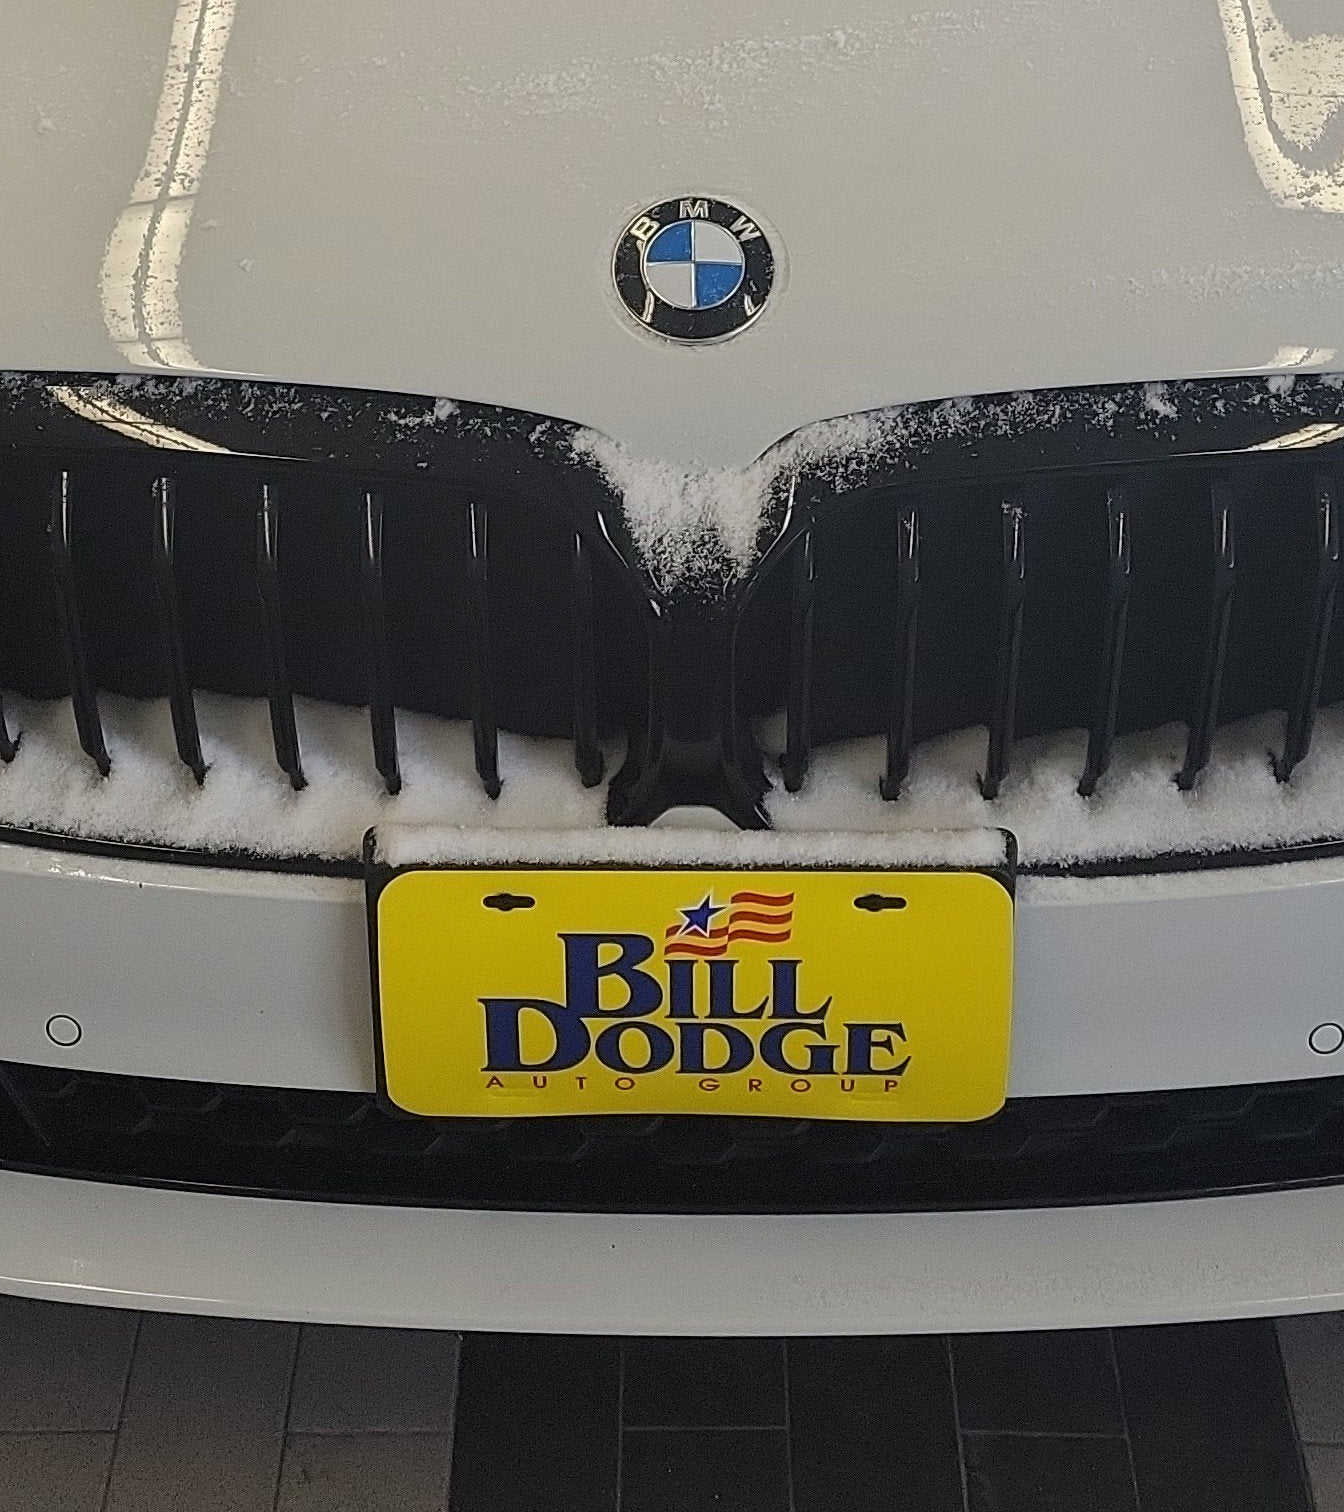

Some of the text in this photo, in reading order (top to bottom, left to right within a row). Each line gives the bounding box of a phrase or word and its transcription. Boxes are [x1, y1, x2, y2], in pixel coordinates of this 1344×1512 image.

[629, 199, 761, 242] BMW
[556, 932, 833, 1019] BILL
[477, 998, 912, 1076] DODGE
[484, 1075, 900, 1094] AUTO GROUP
